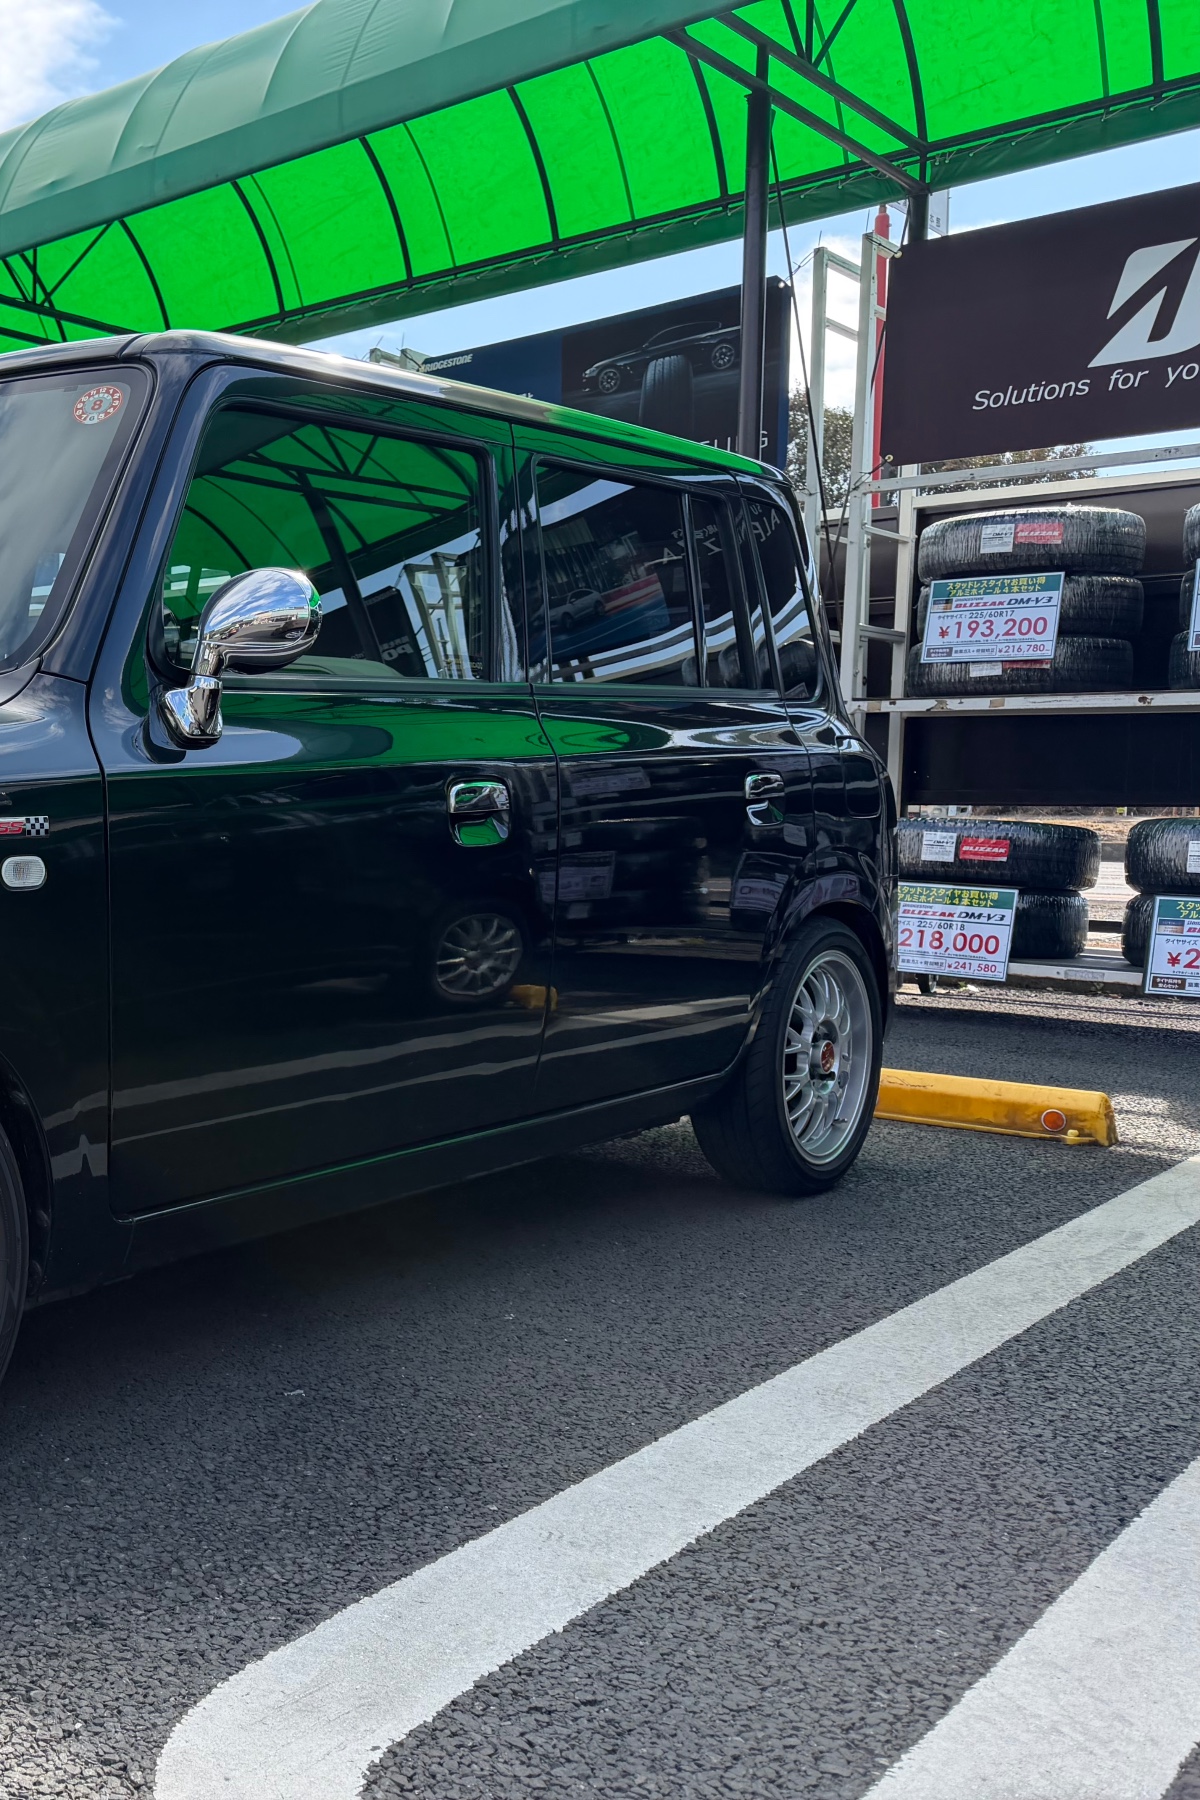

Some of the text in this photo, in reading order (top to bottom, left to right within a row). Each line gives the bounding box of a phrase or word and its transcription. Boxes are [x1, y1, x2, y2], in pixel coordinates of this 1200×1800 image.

[972, 379, 1091, 411] Solutions
[1108, 369, 1149, 391] for
[91, 399, 103, 411] 8
[946, 576, 1046, 590] スタッドレスタイヤお買い得
[949, 585, 1042, 597] アルミホイール4本セット
[953, 596, 1053, 609] BLIZZAK DM-V3
[968, 610, 1015, 619] 225/60R17
[938, 616, 1048, 640] ¥193,200
[998, 643, 1045, 654] ¥216,780
[962, 845, 1006, 853] BLIZZAK
[901, 908, 1006, 922] BLIZZAK DM-V3
[916, 920, 966, 930] 225/60R18
[947, 960, 997, 973] ¥241,580
